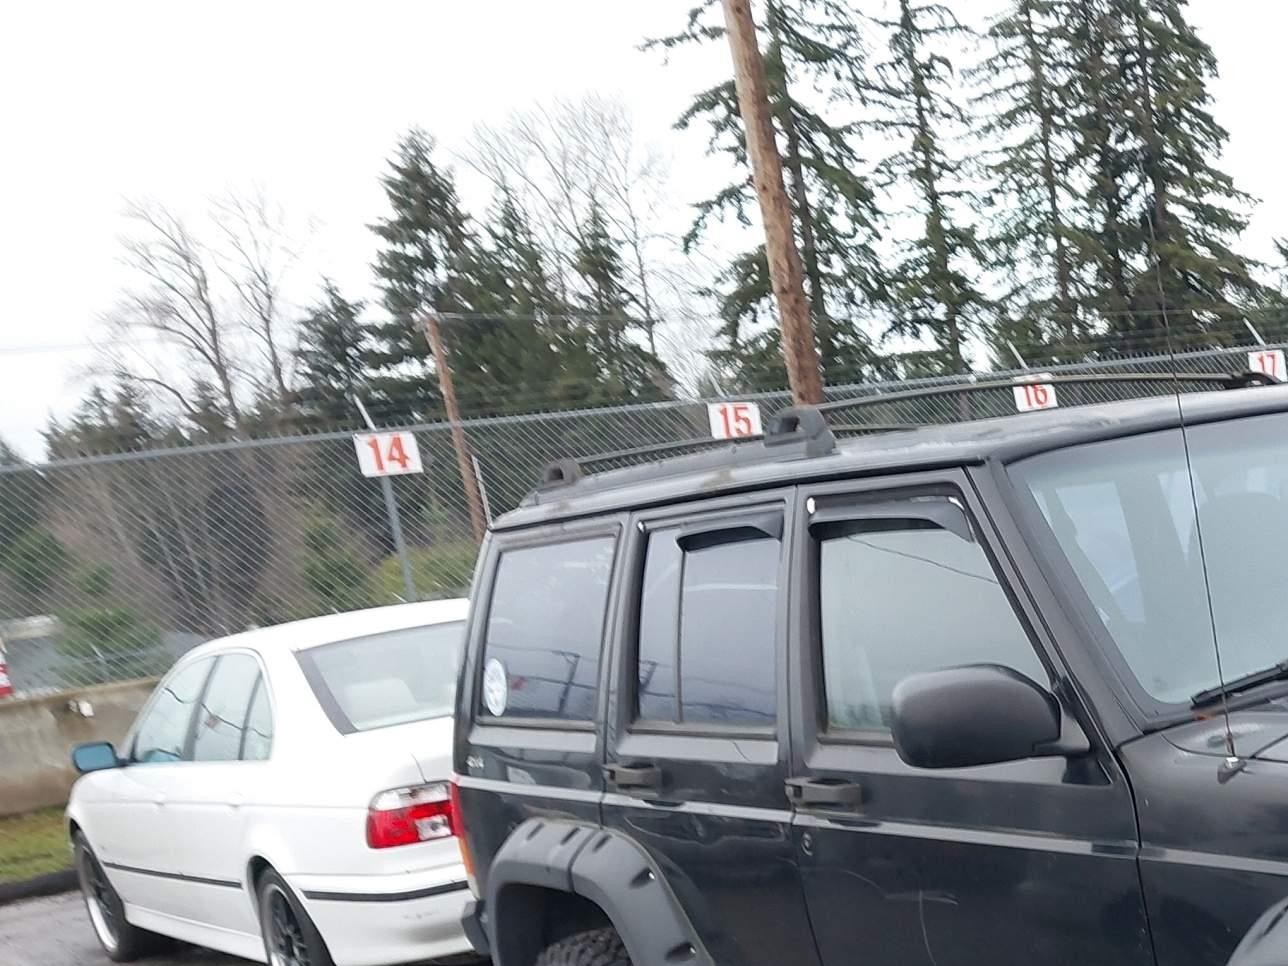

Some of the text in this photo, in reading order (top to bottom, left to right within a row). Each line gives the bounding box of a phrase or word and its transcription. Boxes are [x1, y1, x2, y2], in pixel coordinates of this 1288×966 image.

[1257, 353, 1275, 378] 17
[1024, 384, 1048, 407] 16
[719, 405, 752, 439] 15
[367, 434, 410, 472] 14
